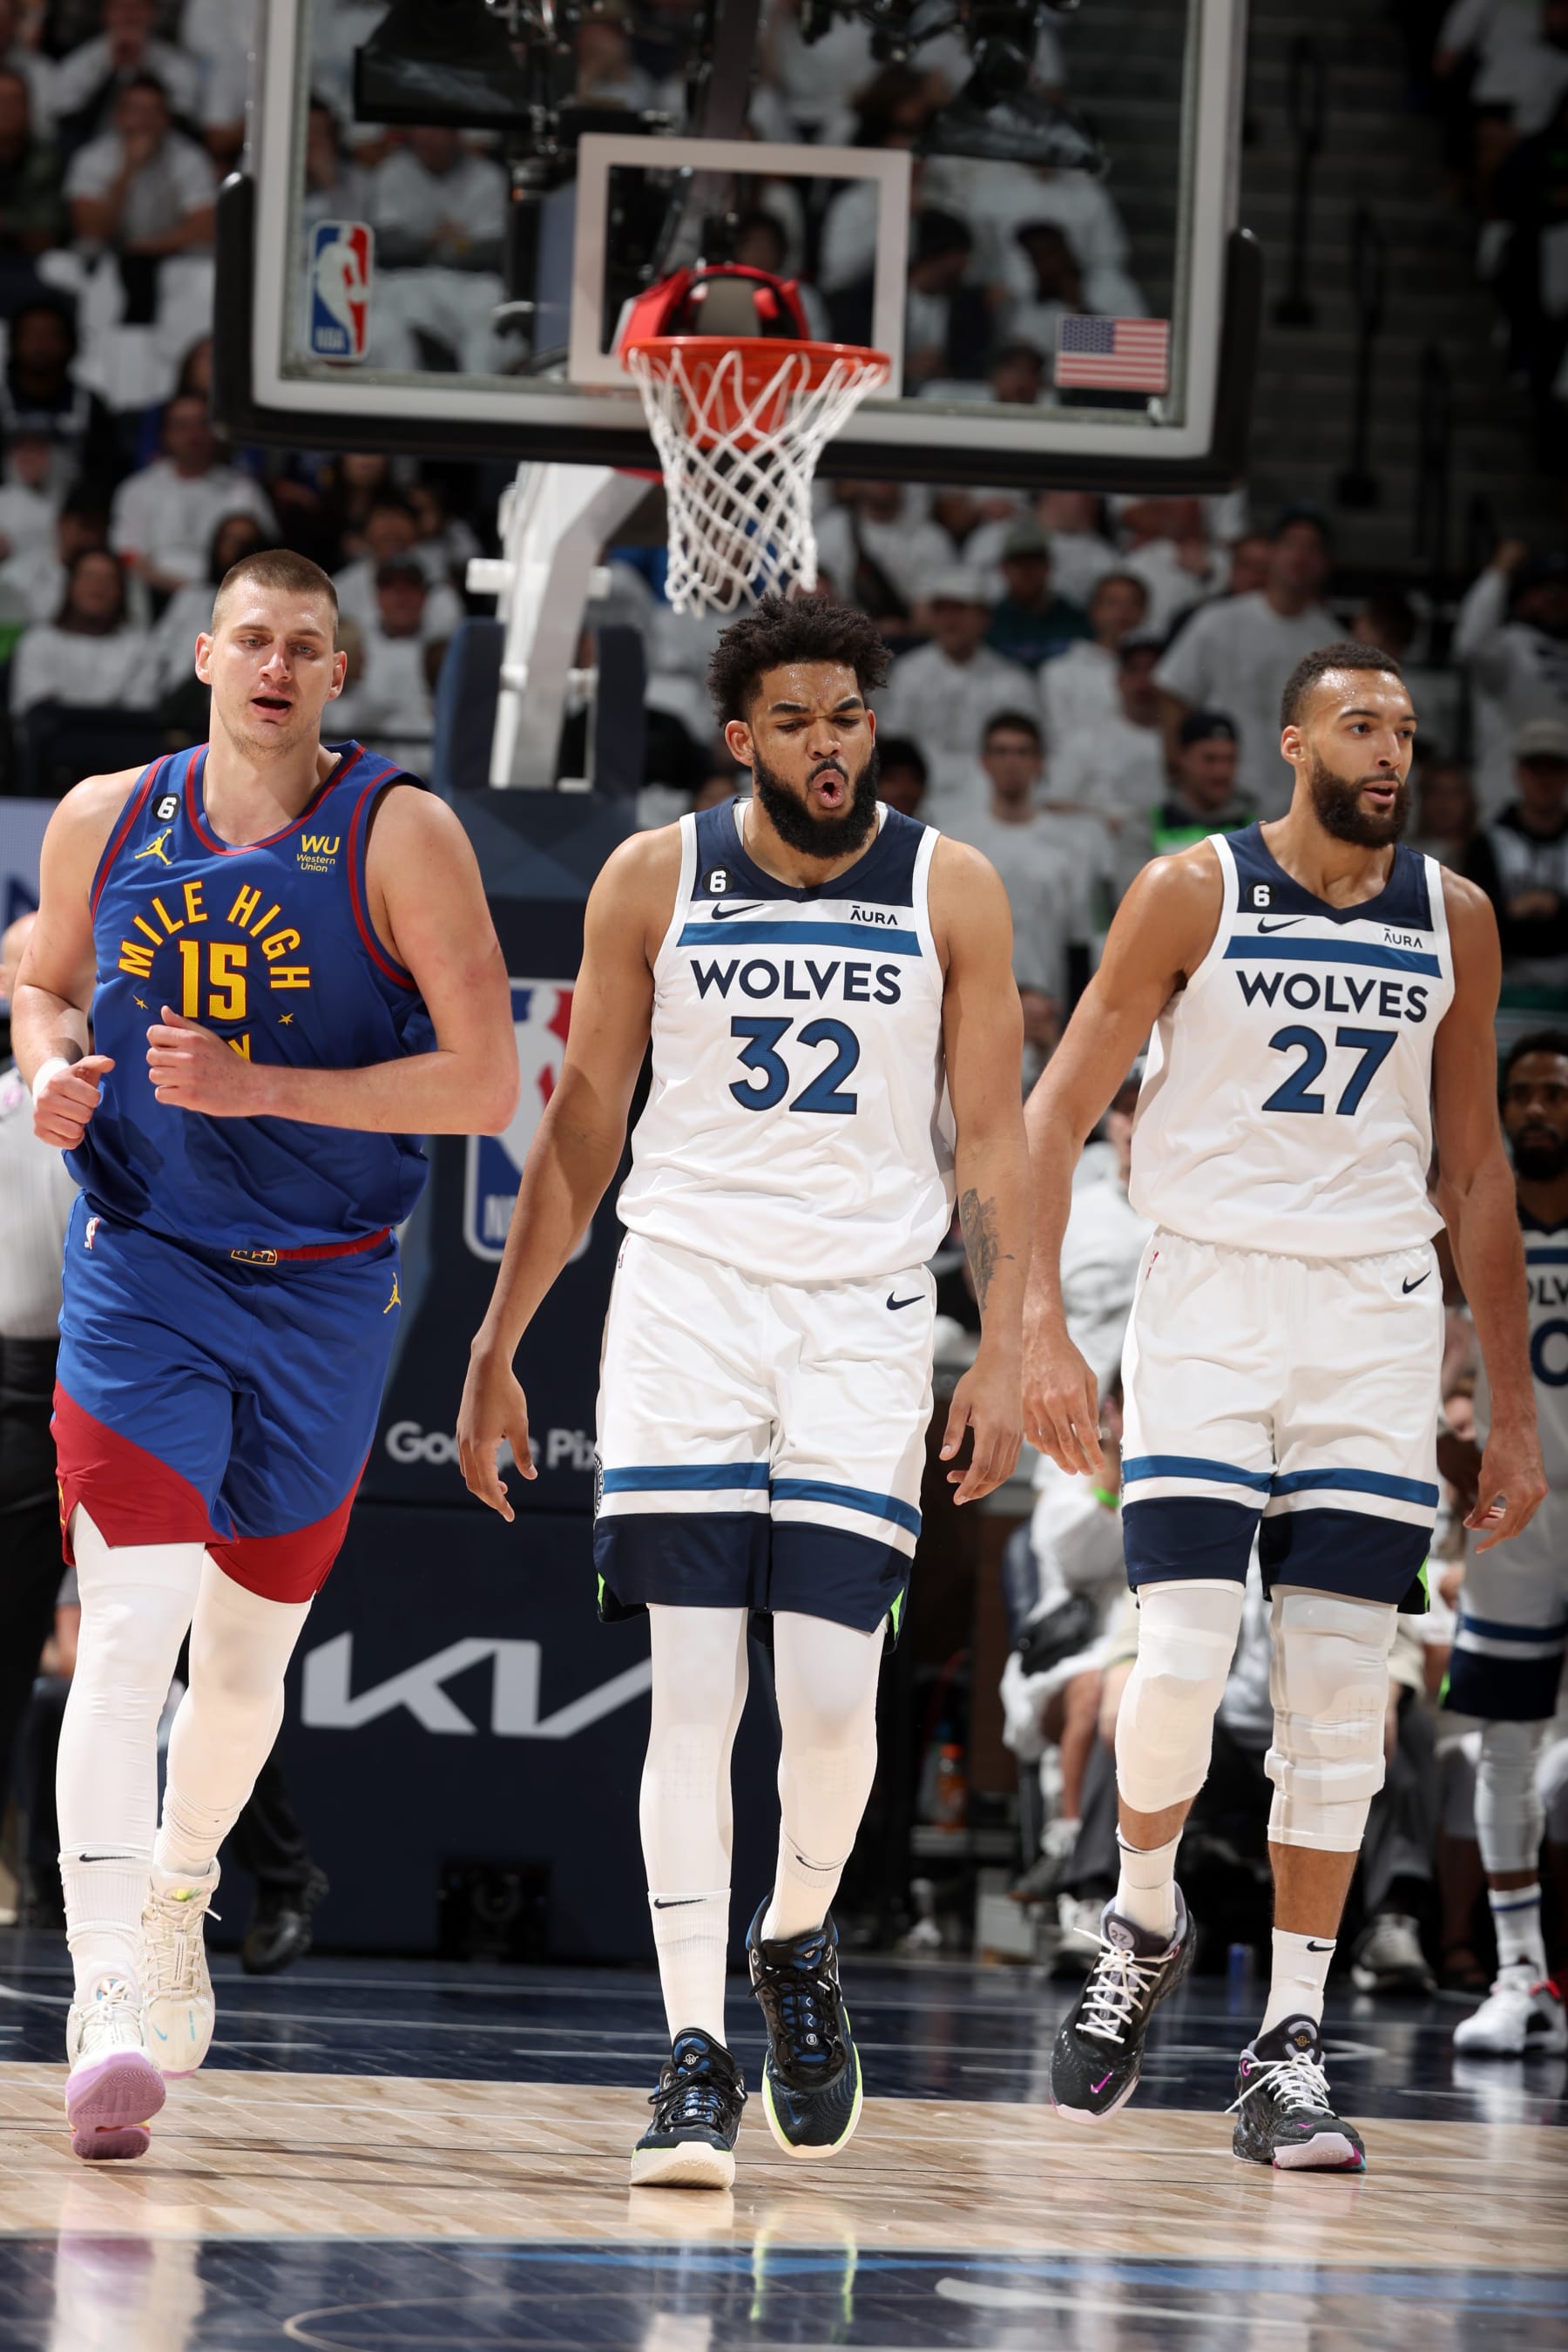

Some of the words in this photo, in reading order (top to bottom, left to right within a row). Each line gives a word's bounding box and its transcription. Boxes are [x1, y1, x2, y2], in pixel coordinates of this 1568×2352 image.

[158, 797, 177, 819] 6
[301, 834, 341, 855] WU
[296, 853, 336, 865] Western
[301, 862, 328, 873] Union
[709, 870, 727, 893] 6
[1254, 885, 1270, 907] 6
[118, 881, 209, 980] MILE
[226, 883, 311, 990] HIGH
[178, 940, 248, 1021] 15
[690, 959, 902, 1005] WOLVES
[1235, 970, 1429, 1024] WOLVES
[728, 1016, 861, 1115] 32
[1261, 1024, 1399, 1117] 27
[1112, 1930, 1127, 1942] 27
